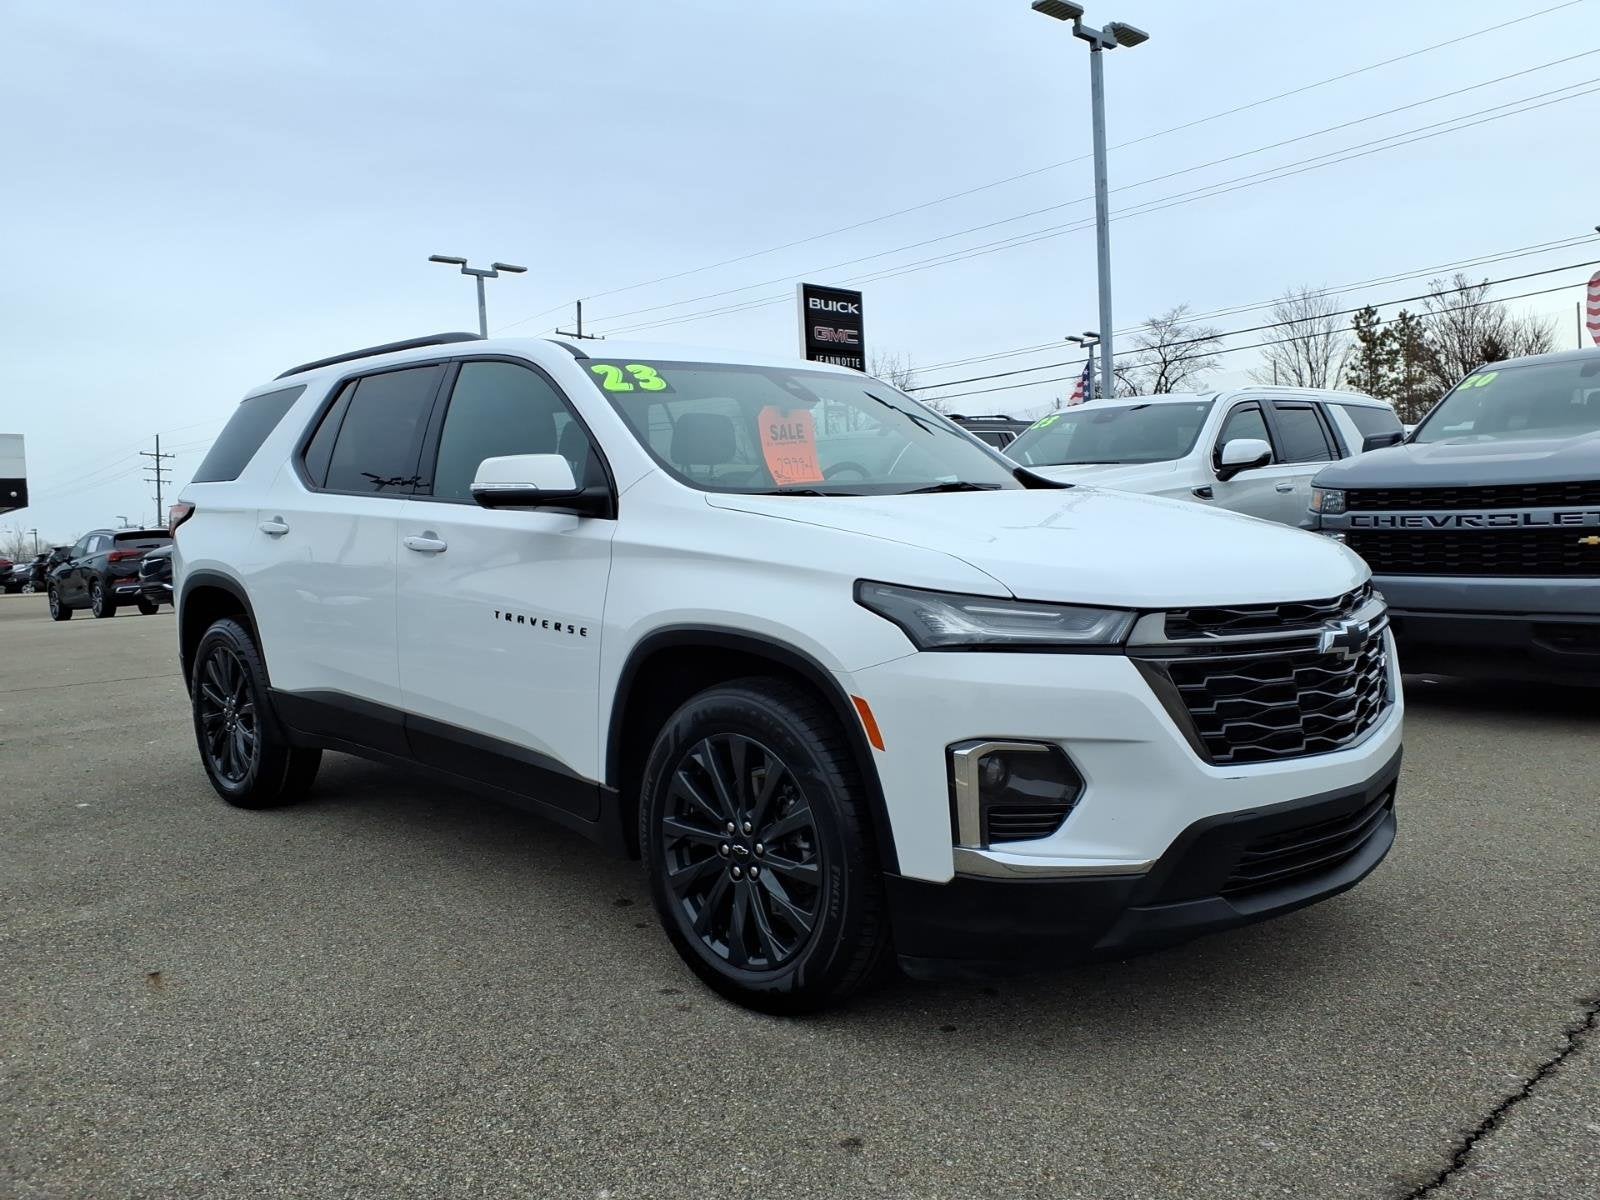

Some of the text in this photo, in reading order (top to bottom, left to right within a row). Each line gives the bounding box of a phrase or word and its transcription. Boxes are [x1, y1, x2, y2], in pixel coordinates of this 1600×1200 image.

[808, 297, 860, 314] BUICK
[814, 325, 859, 345] GMC
[815, 354, 861, 368] JEANNOTTE
[590, 364, 667, 391] 23
[769, 423, 805, 441] SALE
[494, 610, 588, 637] TRAVERSE
